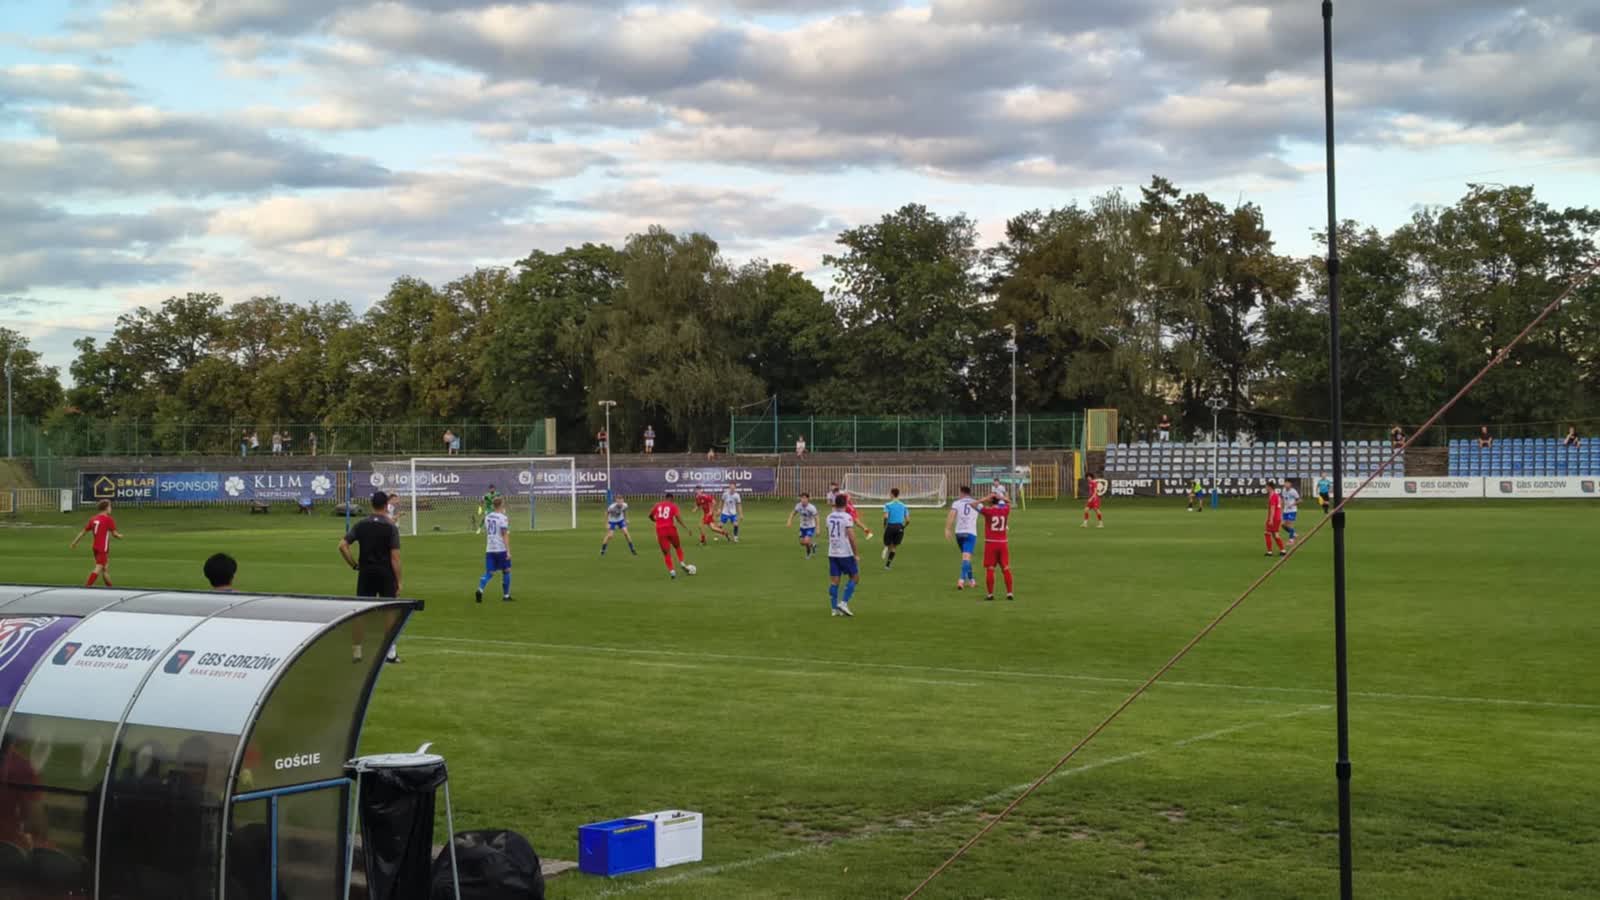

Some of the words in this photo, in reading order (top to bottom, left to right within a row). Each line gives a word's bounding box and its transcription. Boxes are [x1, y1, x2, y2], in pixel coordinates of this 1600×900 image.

[117, 479, 155, 487] SOLAR
[161, 481, 218, 492] SPONSOR
[254, 475, 302, 488] KLIM
[1111, 479, 1152, 487] SEKRET
[117, 489, 150, 497] HOME
[658, 506, 671, 519] 18
[963, 503, 971, 516] 6
[93, 520, 101, 535] 7
[830, 519, 841, 538] 21
[991, 515, 1006, 532] 21
[84, 644, 111, 658] GBS
[107, 645, 160, 662] GORZÓW
[198, 652, 226, 666] GBS
[223, 653, 281, 671] GORZÓW
[274, 752, 321, 770] GOŚCIE
